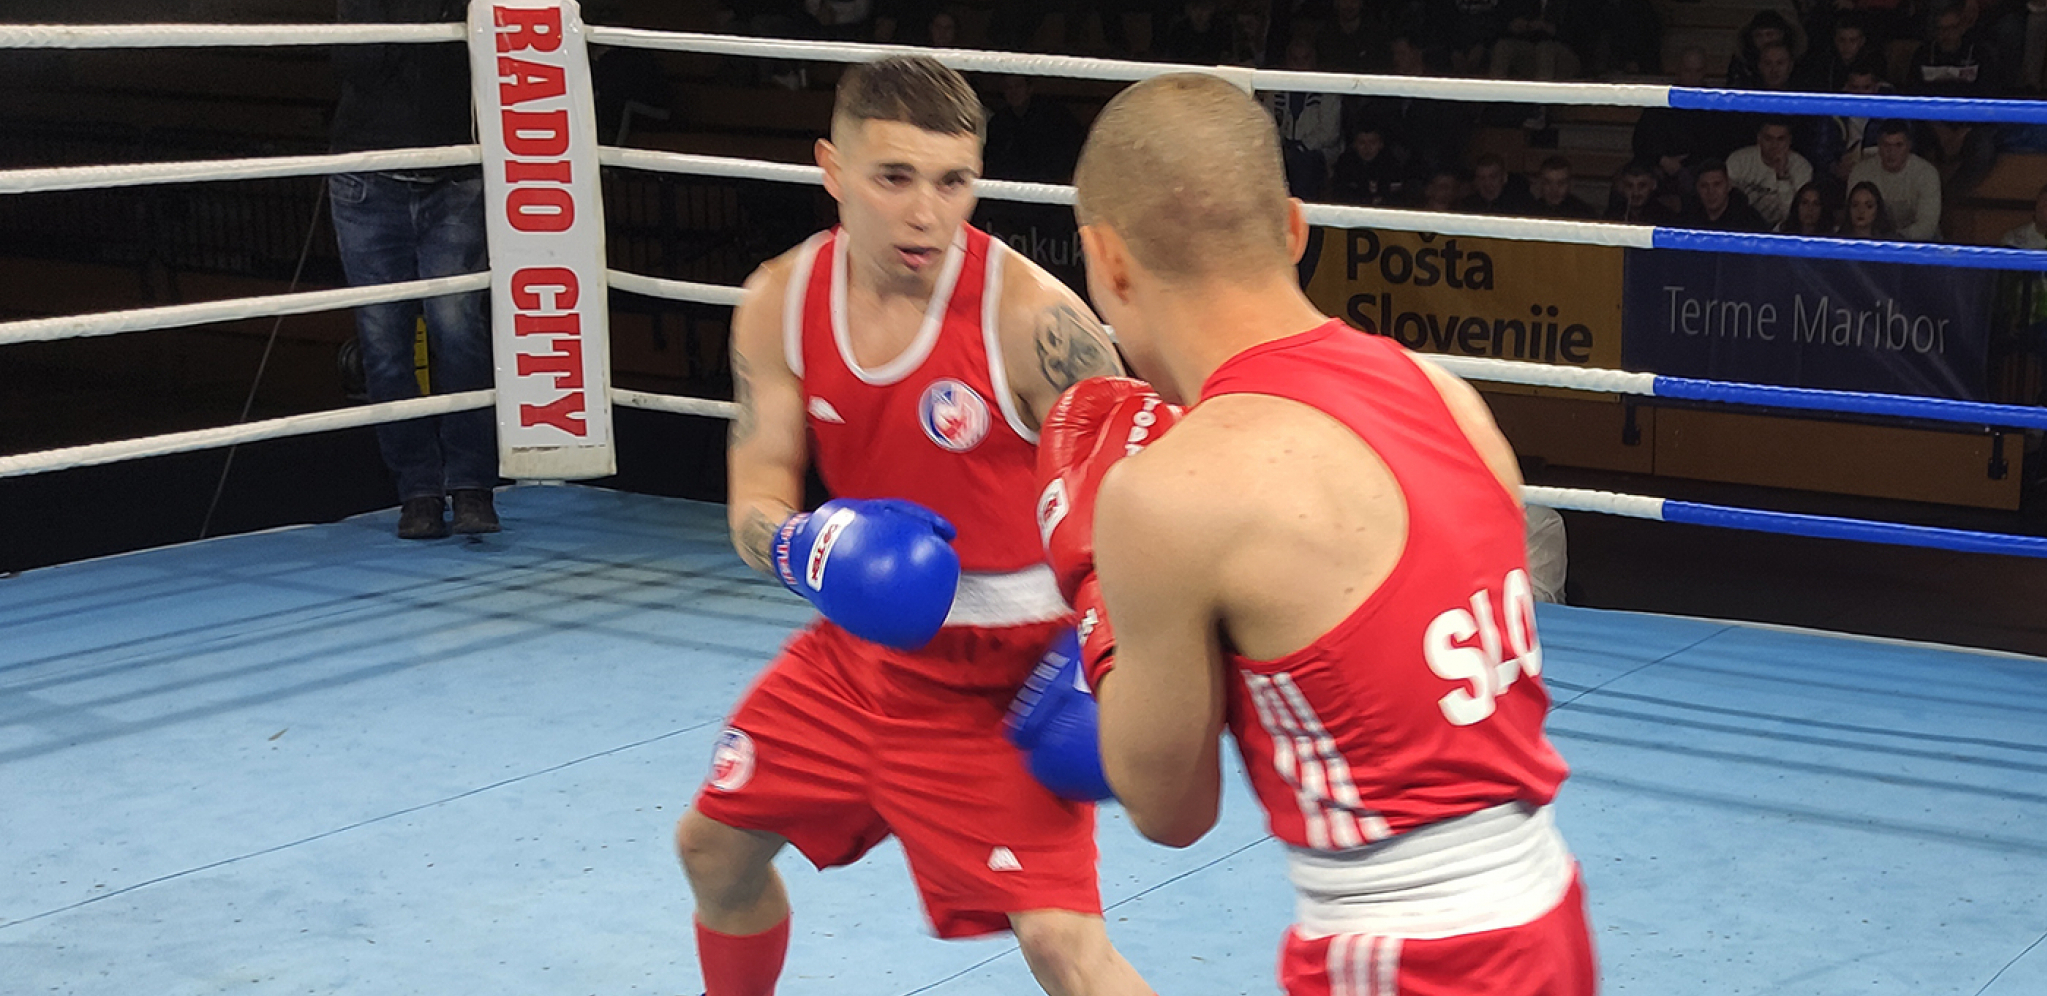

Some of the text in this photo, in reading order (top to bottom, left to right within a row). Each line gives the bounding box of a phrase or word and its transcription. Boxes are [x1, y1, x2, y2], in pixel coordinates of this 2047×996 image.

[493, 5, 588, 438] RADIO CITY
[1346, 229, 1494, 291] Pošta
[1346, 292, 1594, 364] Slovenije
[1663, 286, 1951, 355] Terme Maribor
[1423, 568, 1543, 727] SLO
